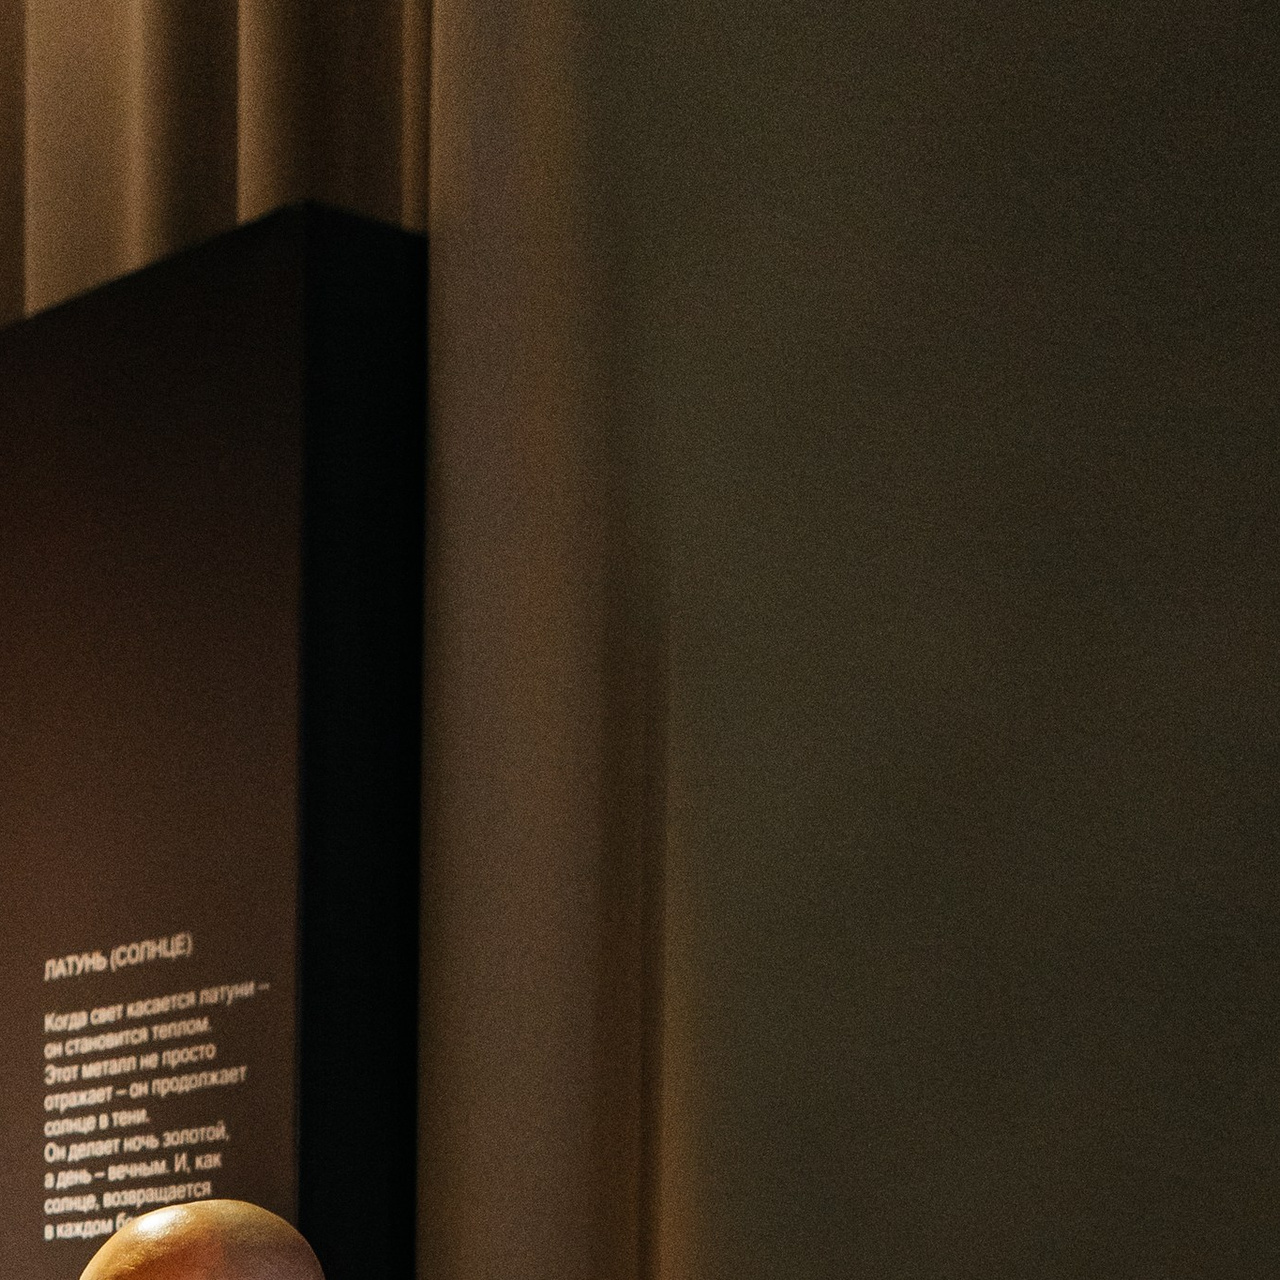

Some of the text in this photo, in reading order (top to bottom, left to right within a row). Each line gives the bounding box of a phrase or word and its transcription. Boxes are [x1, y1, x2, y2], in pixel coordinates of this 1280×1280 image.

[110, 932, 193, 972] (СОЛНЦЕ)
[44, 1011, 89, 1032] Когда
[90, 1004, 123, 1025] свет
[126, 991, 196, 1019] касается
[199, 981, 255, 1005] латуни
[44, 1042, 63, 1059] он
[65, 1027, 149, 1056] становится
[44, 1043, 217, 1085] Этот металл не просто
[44, 1085, 114, 1114] отражает
[129, 1081, 149, 1098] он
[151, 1065, 247, 1098] продолжает
[44, 1108, 151, 1137] солнце в тени.
[44, 1120, 230, 1163] Он делает ночь золотой,
[56, 1168, 92, 1190] день
[174, 1152, 191, 1174] И,
[195, 1152, 223, 1170] как
[44, 1181, 212, 1215] солнце, возвращается
[44, 1224, 55, 1241] в
[56, 1218, 113, 1240] каждом
